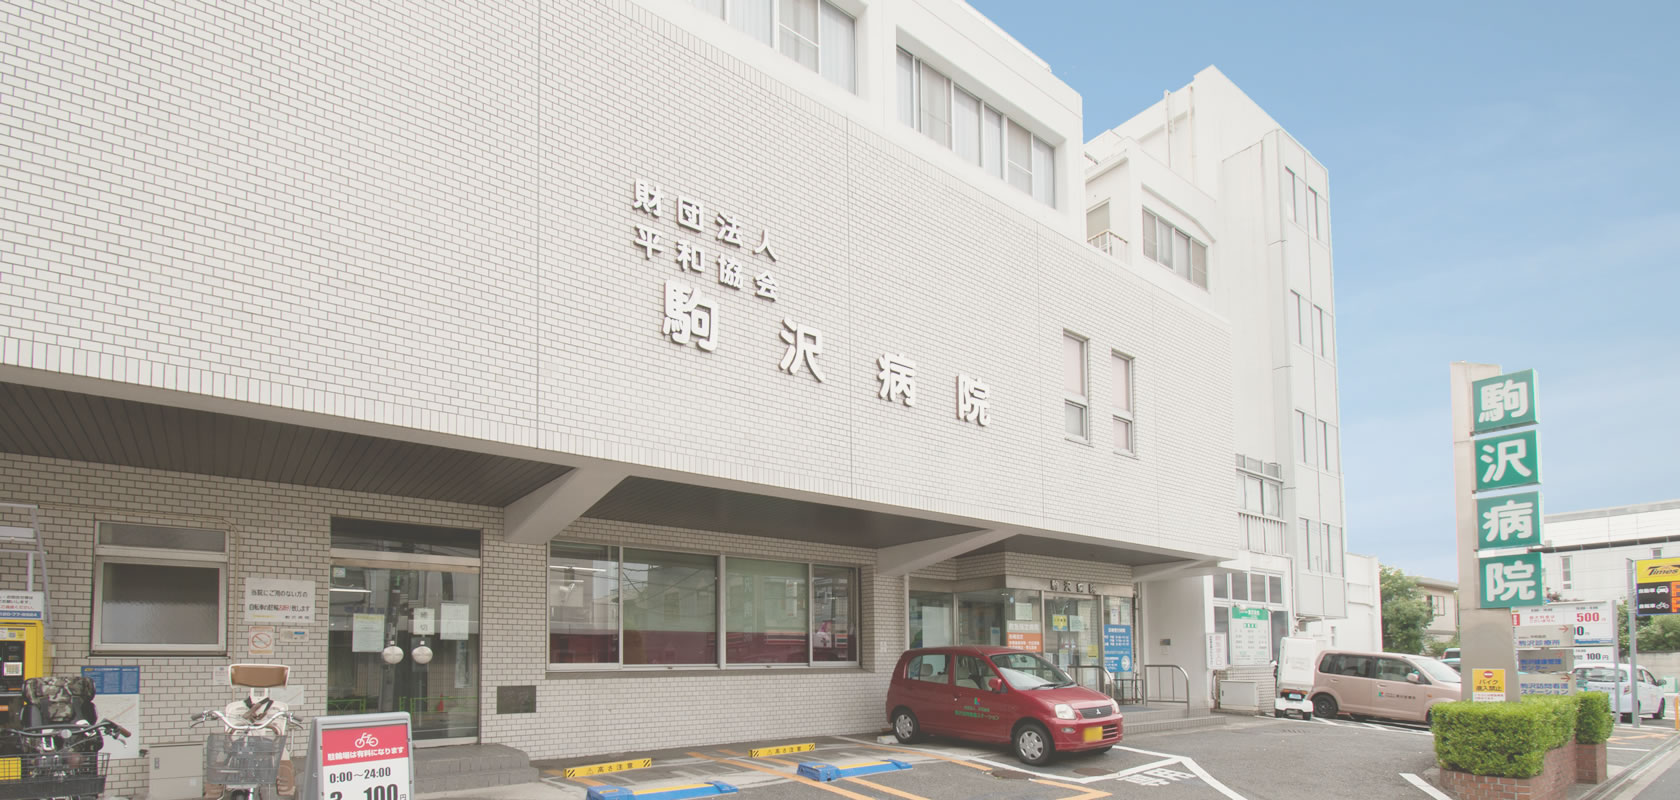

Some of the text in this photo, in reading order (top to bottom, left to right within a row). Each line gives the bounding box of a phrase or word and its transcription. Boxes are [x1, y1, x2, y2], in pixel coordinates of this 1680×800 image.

[662, 280, 993, 428] 駒沢病院
[1478, 379, 1538, 603] 駒沢病院
[1576, 612, 1600, 622] 500
[1573, 625, 1585, 636] 0
[1586, 653, 1602, 661] 100
[327, 746, 405, 761] 駐輪場は有料になります
